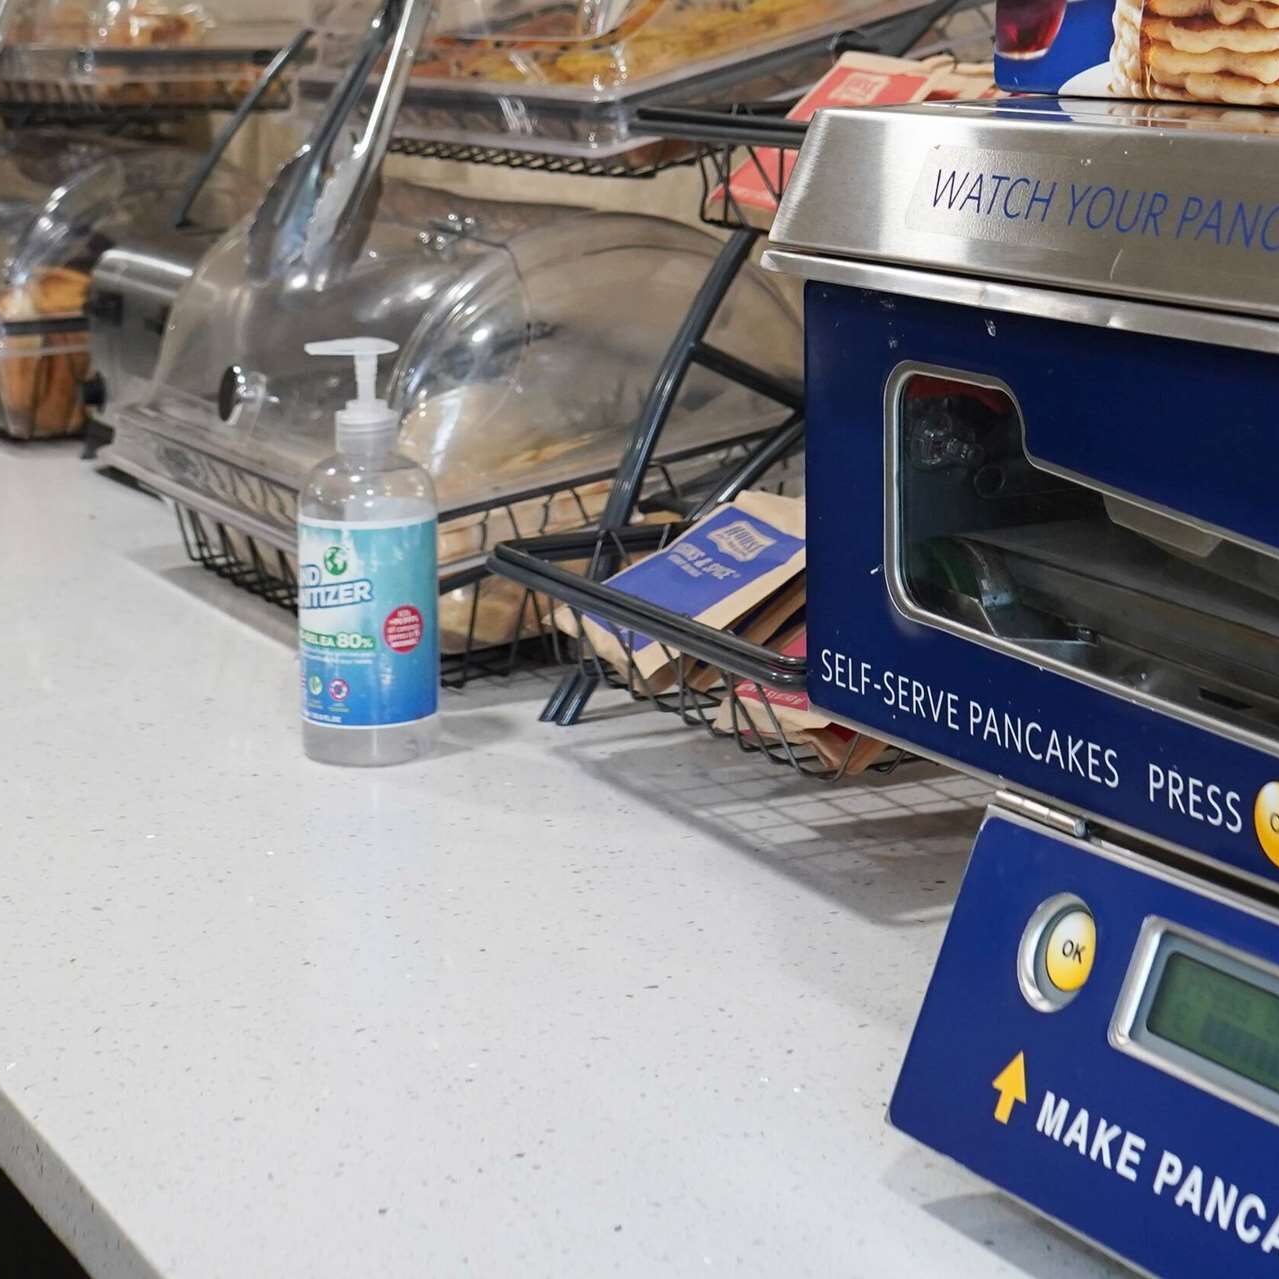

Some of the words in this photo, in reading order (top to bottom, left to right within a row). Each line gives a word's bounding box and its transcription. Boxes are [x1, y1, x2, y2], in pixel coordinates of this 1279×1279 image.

[931, 168, 1058, 224] WATCH
[1066, 184, 1168, 238] YOUR
[821, 648, 960, 730] SELF-SERVE
[969, 700, 1119, 789] PANCAKES
[1149, 763, 1243, 834] PRESS
[1061, 938, 1086, 967] OK
[1036, 1090, 1147, 1183] MAKE
